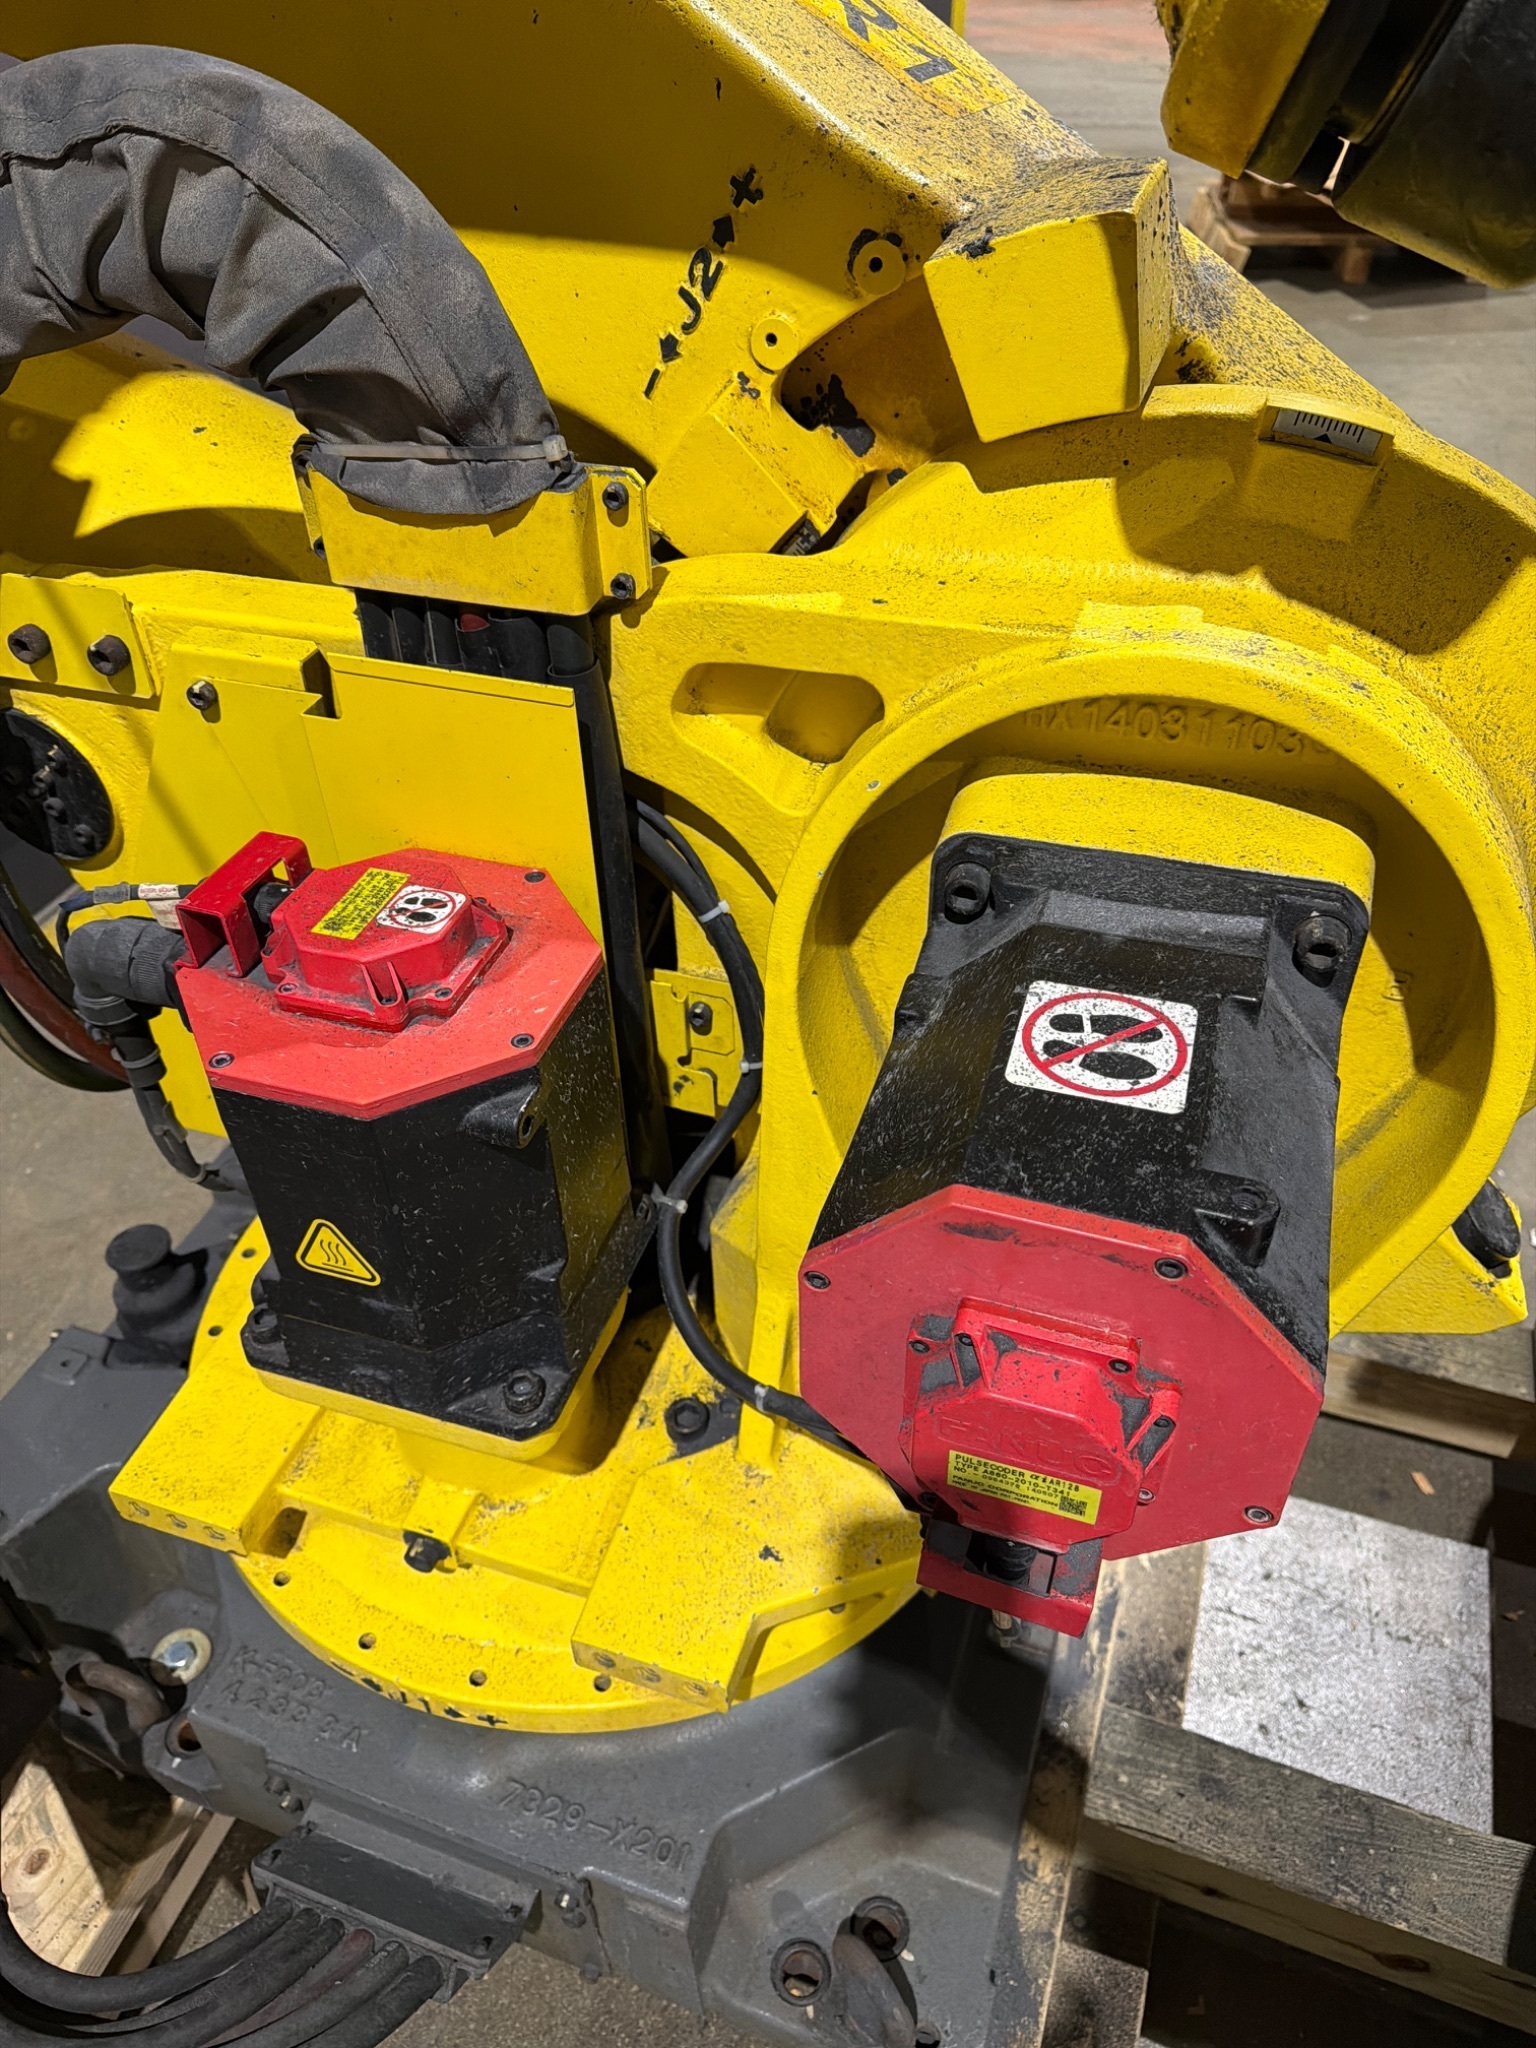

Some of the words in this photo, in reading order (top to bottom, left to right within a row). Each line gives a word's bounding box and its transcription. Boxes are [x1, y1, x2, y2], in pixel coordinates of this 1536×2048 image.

[678, 247, 724, 335] J2
[937, 1414, 1113, 1475] FANUC
[954, 1453, 1025, 1478] PULSECODER
[954, 1460, 979, 1472] TYPE
[952, 1474, 985, 1486] FANUC
[987, 1484, 1058, 1507] CORPORATION
[499, 1777, 692, 1873] 7329-X201
